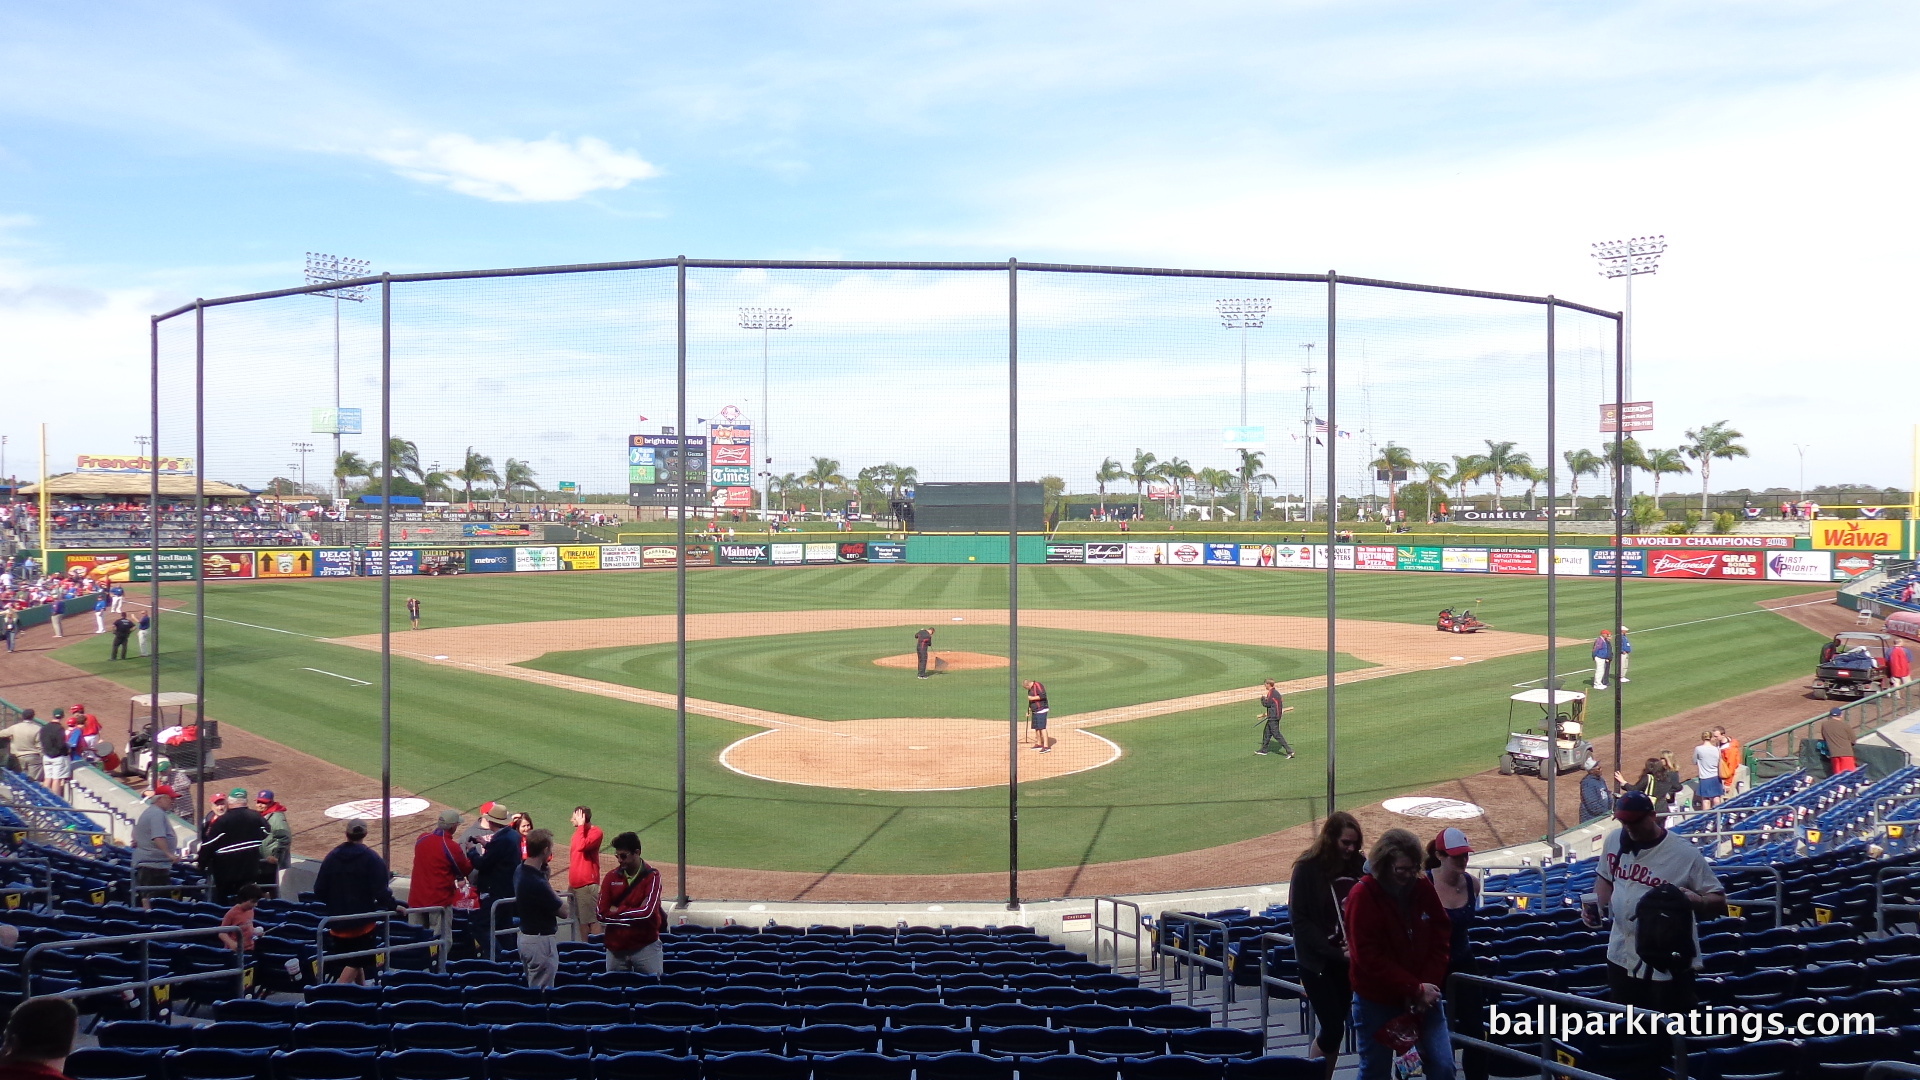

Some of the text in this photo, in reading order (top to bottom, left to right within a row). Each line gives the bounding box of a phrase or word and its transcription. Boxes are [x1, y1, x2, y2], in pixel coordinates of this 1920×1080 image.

[645, 438, 665, 446] bright
[713, 468, 750, 483] Times
[1480, 511, 1528, 519] OAKLEY
[1636, 537, 1681, 546] WORLD
[1686, 537, 1762, 546] CHAMPIONS
[1823, 529, 1889, 547] Wawa
[720, 545, 767, 559] MaintenX
[474, 556, 508, 564] metroPCS
[1722, 554, 1757, 563] GRAB
[1778, 556, 1804, 565] FIRST
[1652, 558, 1717, 570] Budweiser
[1779, 563, 1819, 572] PRIORITY
[1722, 567, 1757, 576] BUDS
[1606, 852, 1669, 888] Phillie
